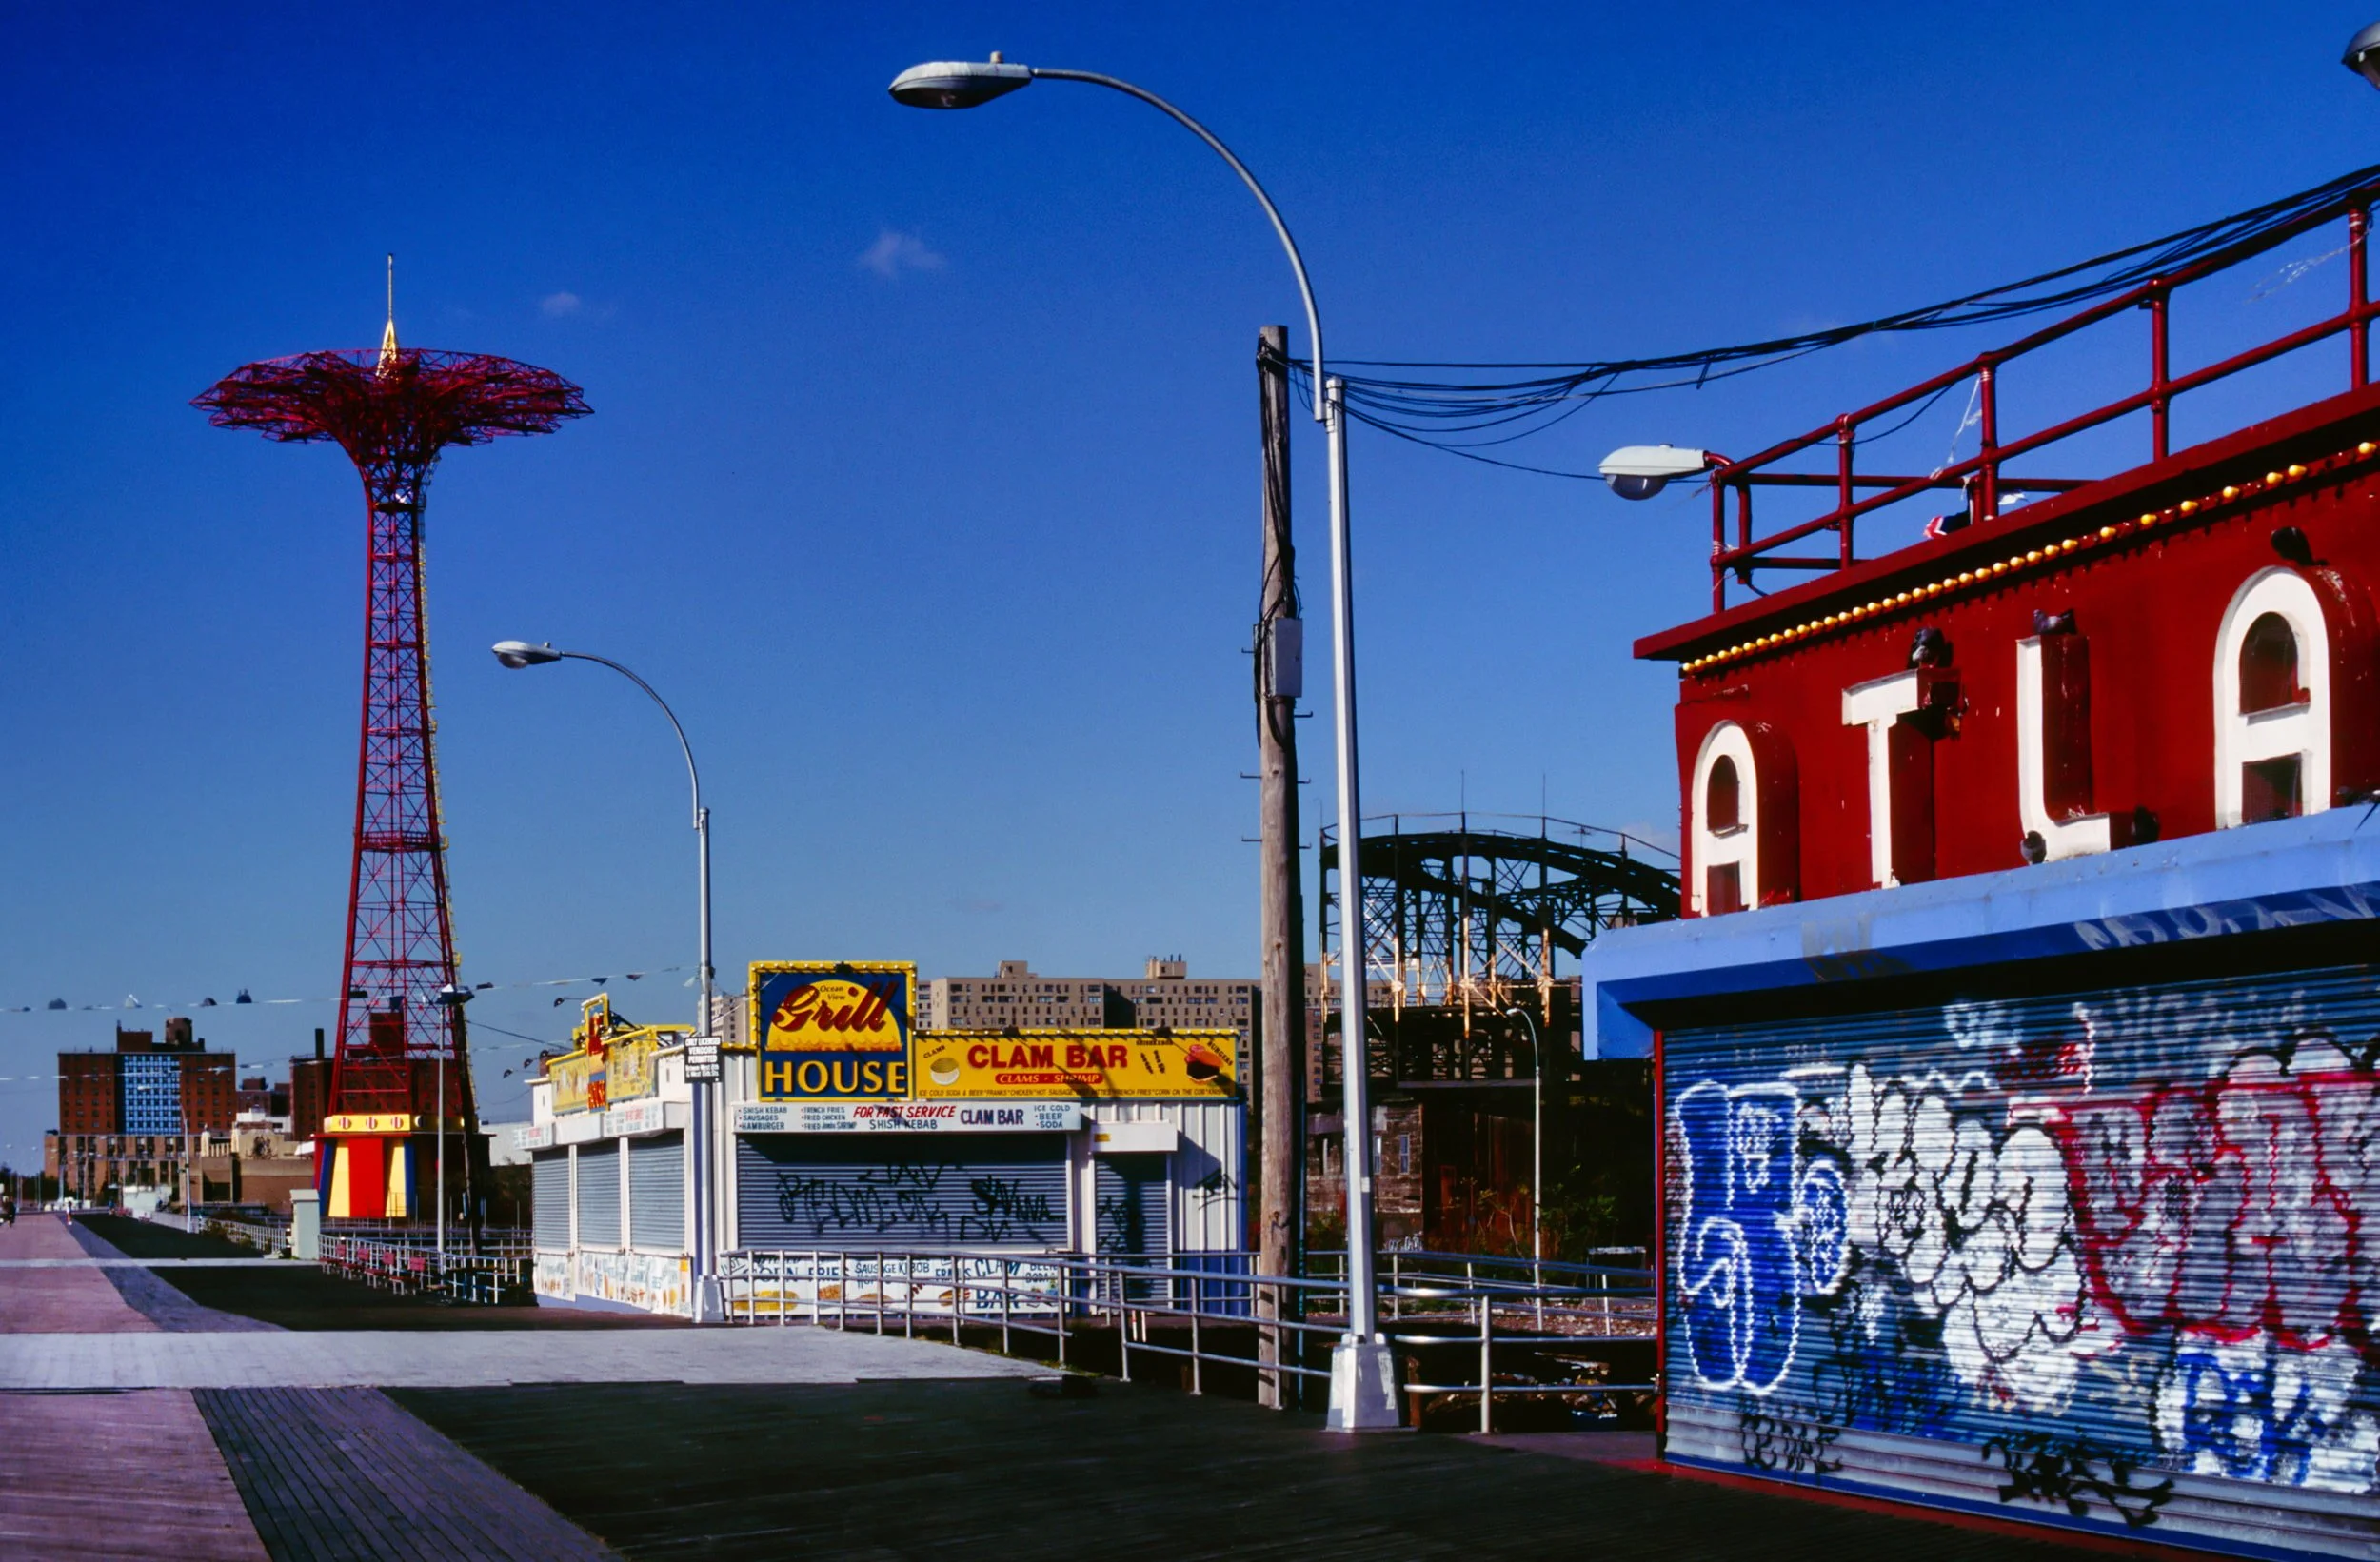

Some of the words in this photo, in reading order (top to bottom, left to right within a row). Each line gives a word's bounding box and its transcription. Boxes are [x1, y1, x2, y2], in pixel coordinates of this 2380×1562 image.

[820, 984, 843, 993] Ocean
[772, 980, 900, 1033] Grill
[922, 1044, 946, 1059] CLAMS
[967, 1044, 1054, 1069] CLAM
[1066, 1044, 1128, 1069] BAR
[764, 1060, 907, 1094] HOUSE
[999, 1074, 1040, 1083] CLAMS
[1054, 1074, 1100, 1084] SHRIMP
[853, 1106, 874, 1117] FOR
[876, 1105, 905, 1118] FAST
[906, 1105, 957, 1118] SERVICE
[960, 1109, 994, 1125] CLAM
[997, 1108, 1024, 1125] BAR
[869, 1118, 901, 1130] SHISH
[903, 1118, 938, 1129] KEBAB
[854, 1262, 898, 1275] SAUSGE
[899, 1261, 930, 1275] KBOB
